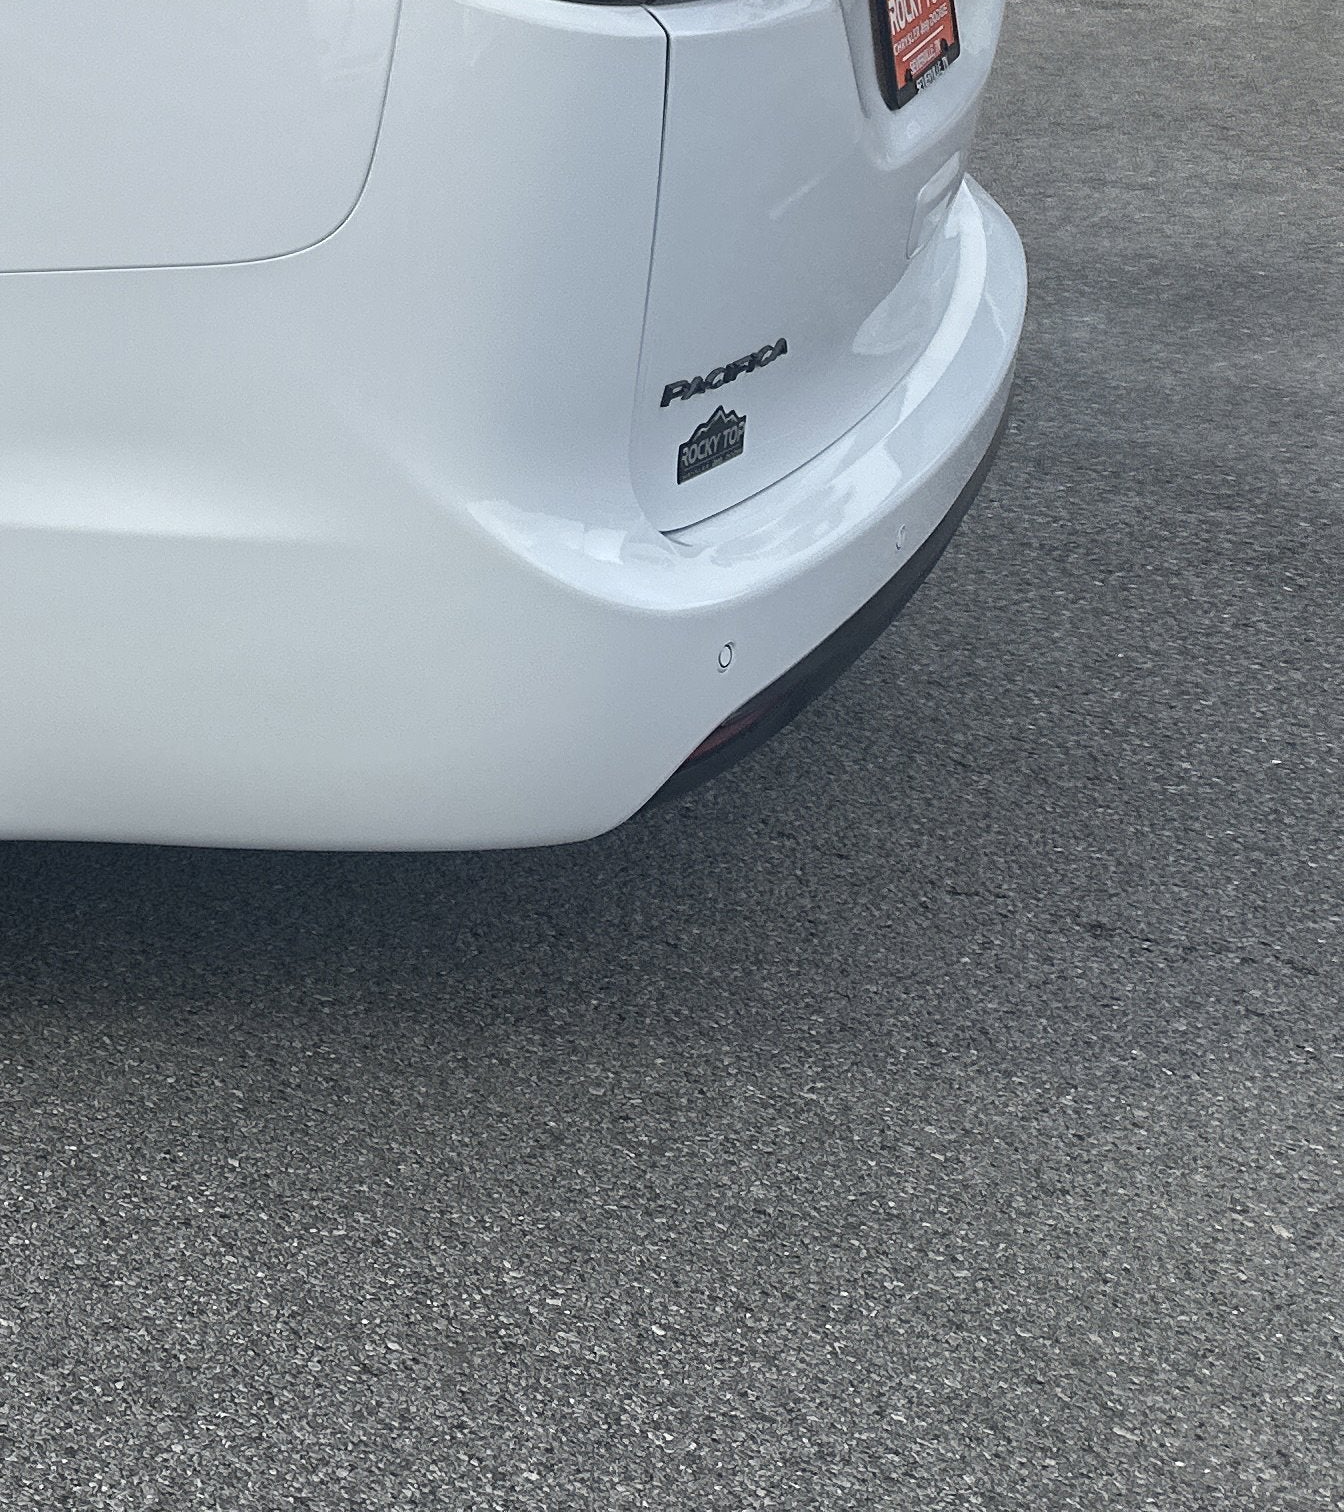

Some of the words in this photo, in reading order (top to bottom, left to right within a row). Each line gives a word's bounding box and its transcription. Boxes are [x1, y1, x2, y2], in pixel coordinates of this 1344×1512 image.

[660, 338, 788, 408] PACIFICA
[681, 432, 722, 467] ROCKY
[723, 421, 746, 449] TOP
